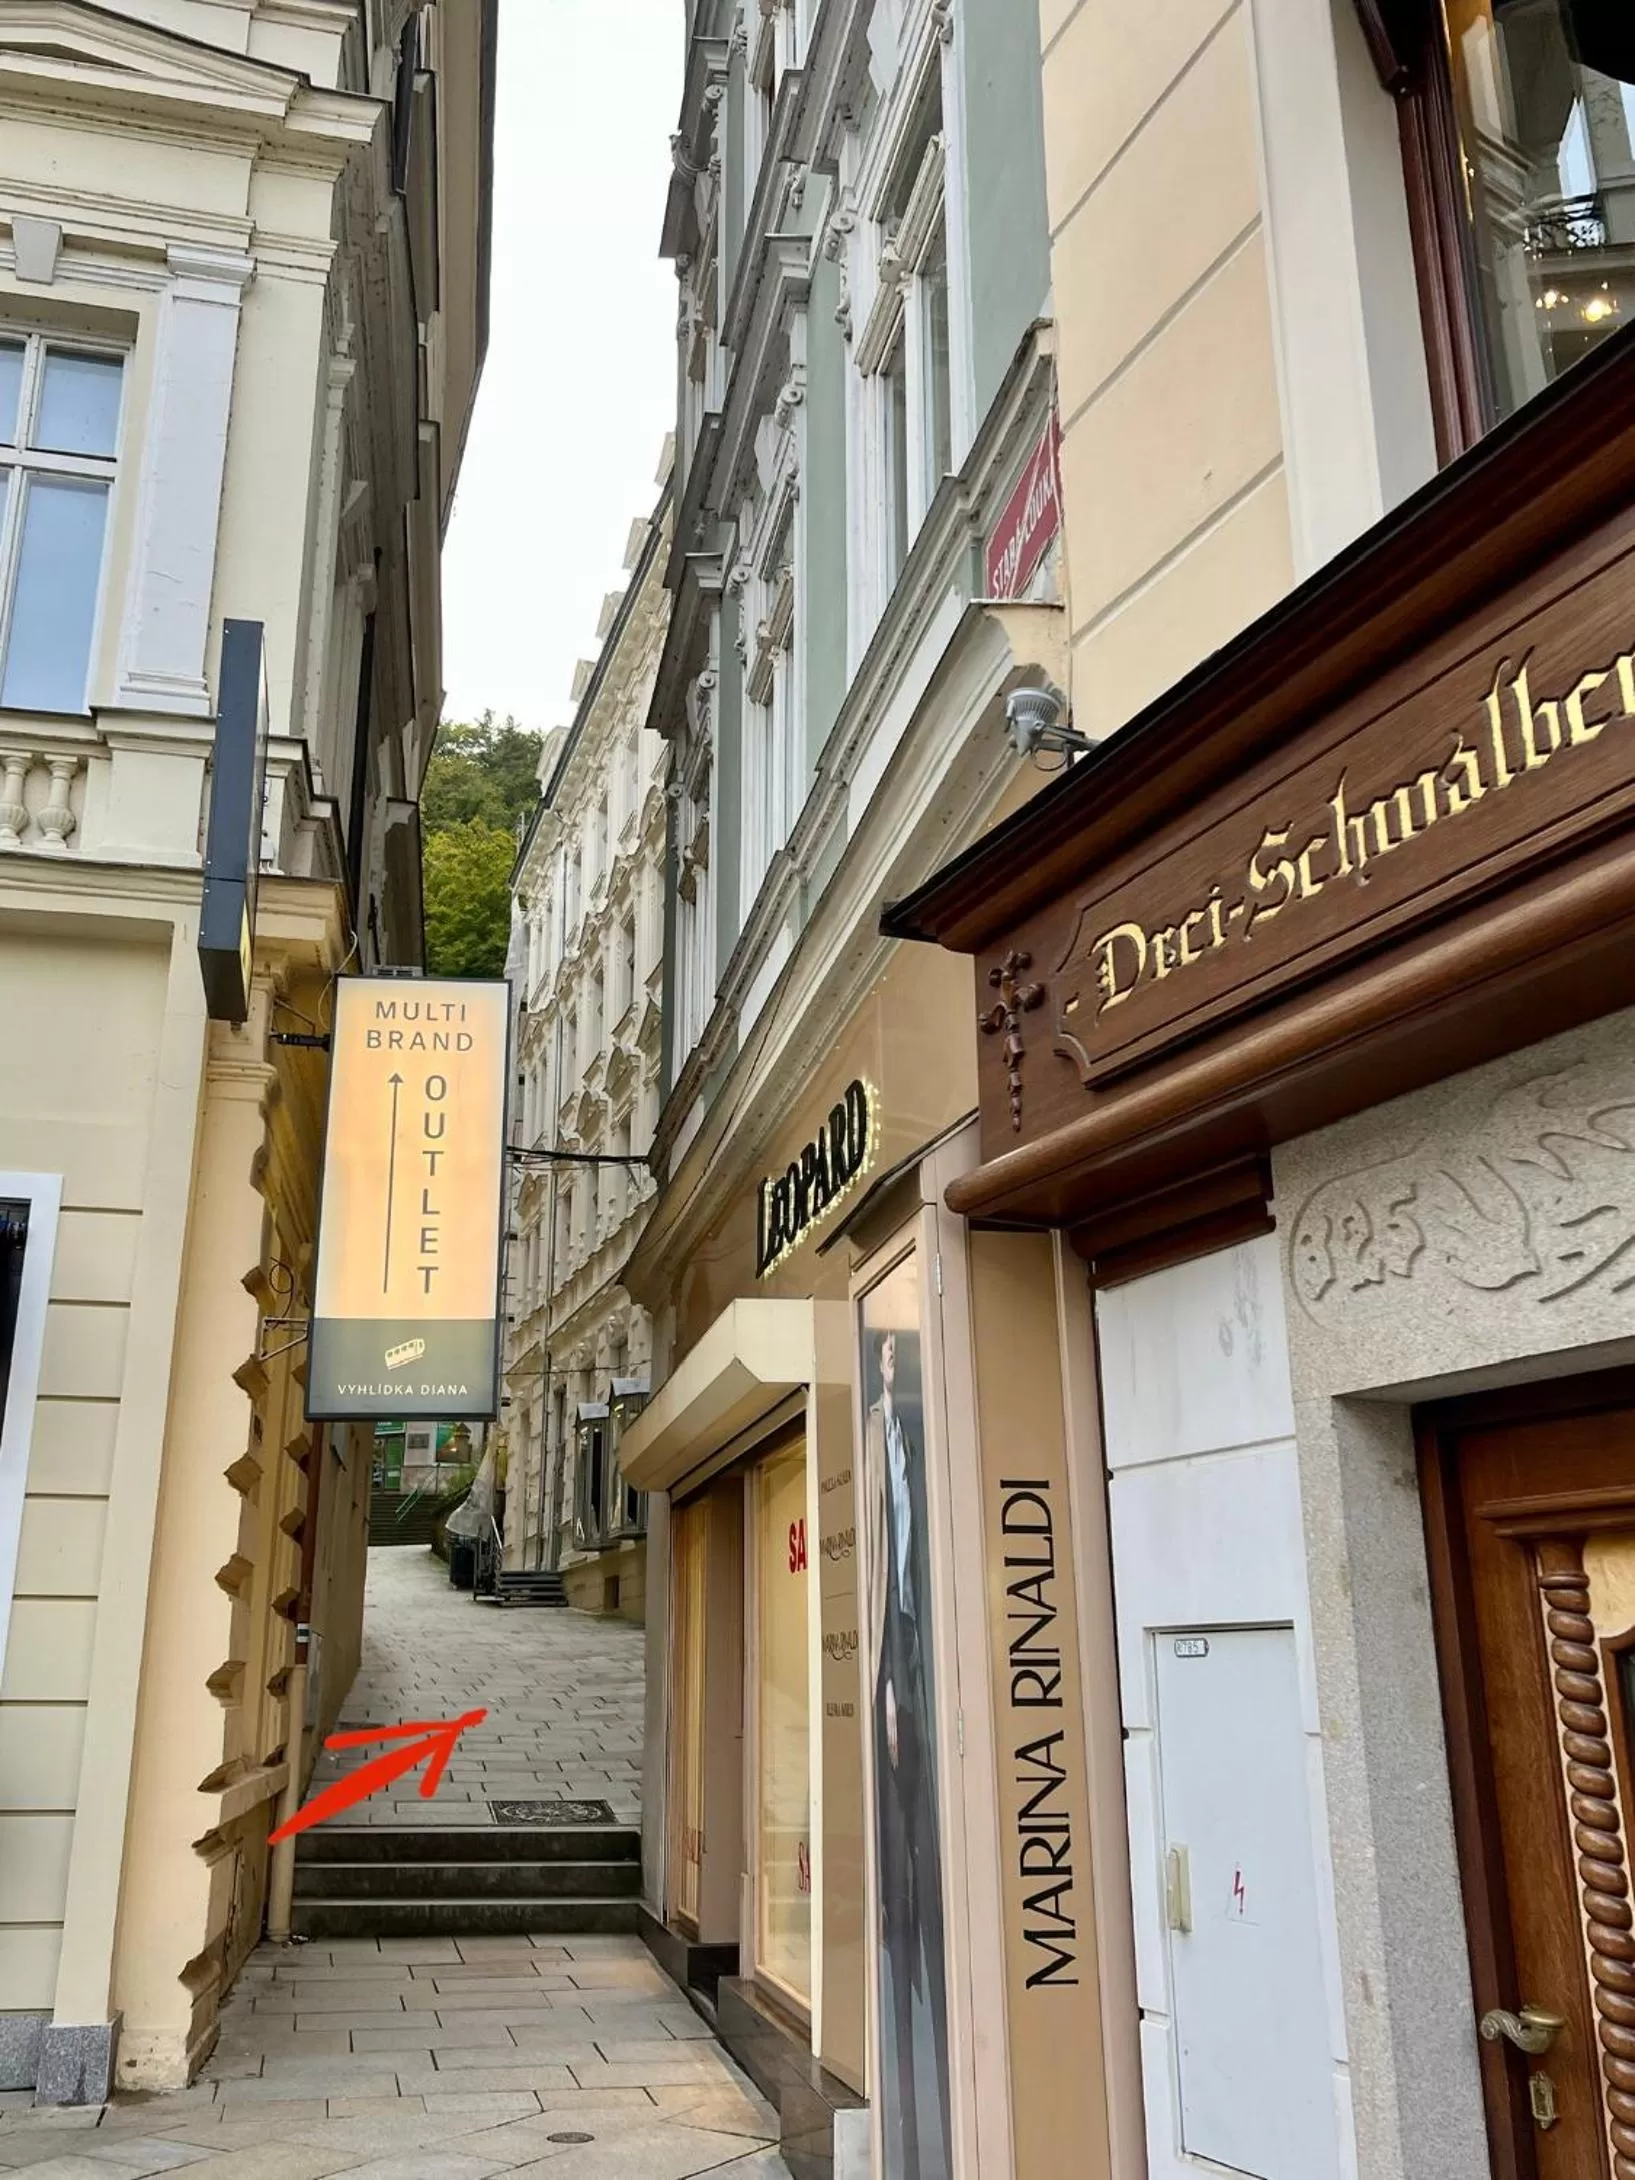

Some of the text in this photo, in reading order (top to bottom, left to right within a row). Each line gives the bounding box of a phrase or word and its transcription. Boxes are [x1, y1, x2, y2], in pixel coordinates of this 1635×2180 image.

[366, 1029, 474, 1053] BRAND
[375, 1000, 467, 1023] MULTI
[416, 1073, 448, 1295] OUTLET
[755, 1079, 868, 1280] LEOPARD
[337, 1382, 468, 1396] VYHLÍDKA DIANA
[999, 1479, 1079, 1990] MARINA RINALDI
